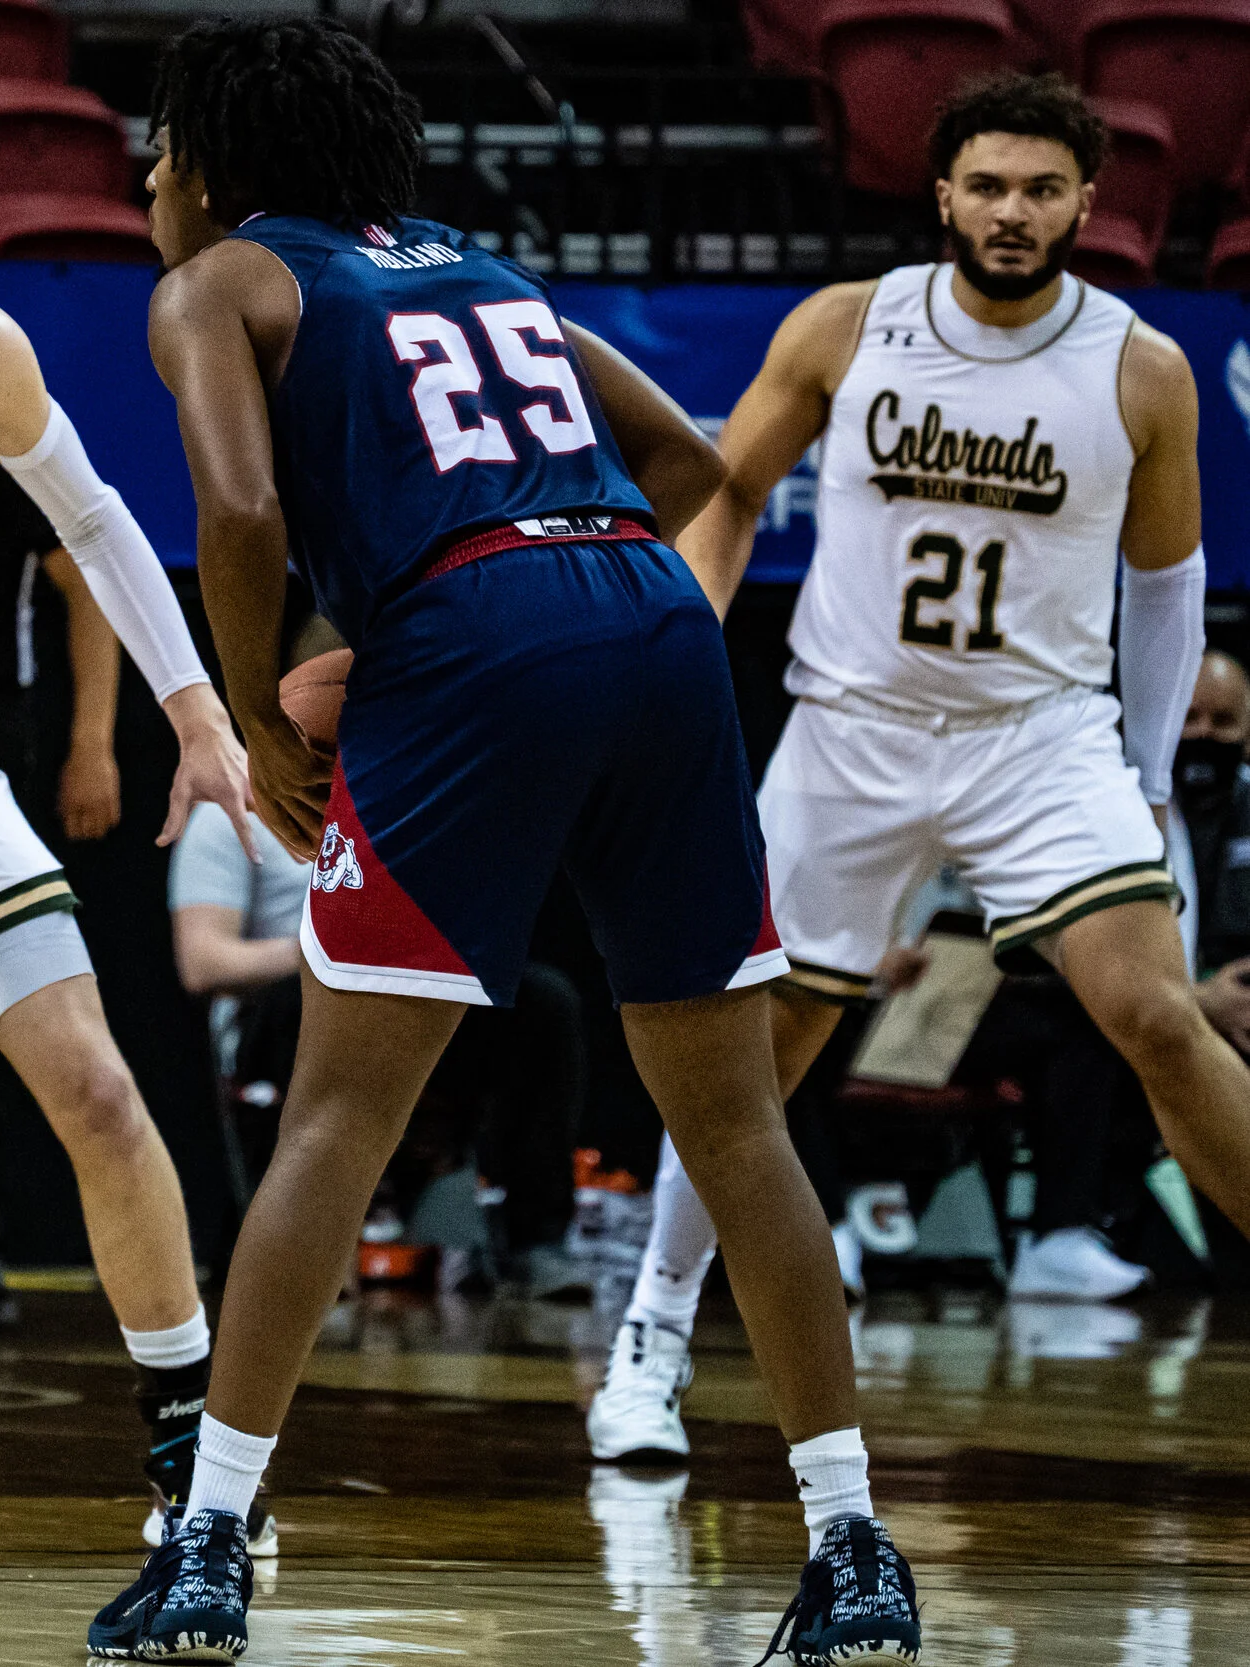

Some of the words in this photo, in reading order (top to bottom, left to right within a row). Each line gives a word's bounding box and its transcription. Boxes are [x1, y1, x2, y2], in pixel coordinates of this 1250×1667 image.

[354, 243, 463, 269] HOLLAND
[385, 299, 598, 476] 25
[866, 390, 1066, 486] Colorado
[914, 478, 964, 501] STATE
[975, 487, 1018, 509] UNIV
[900, 531, 1008, 651] 21
